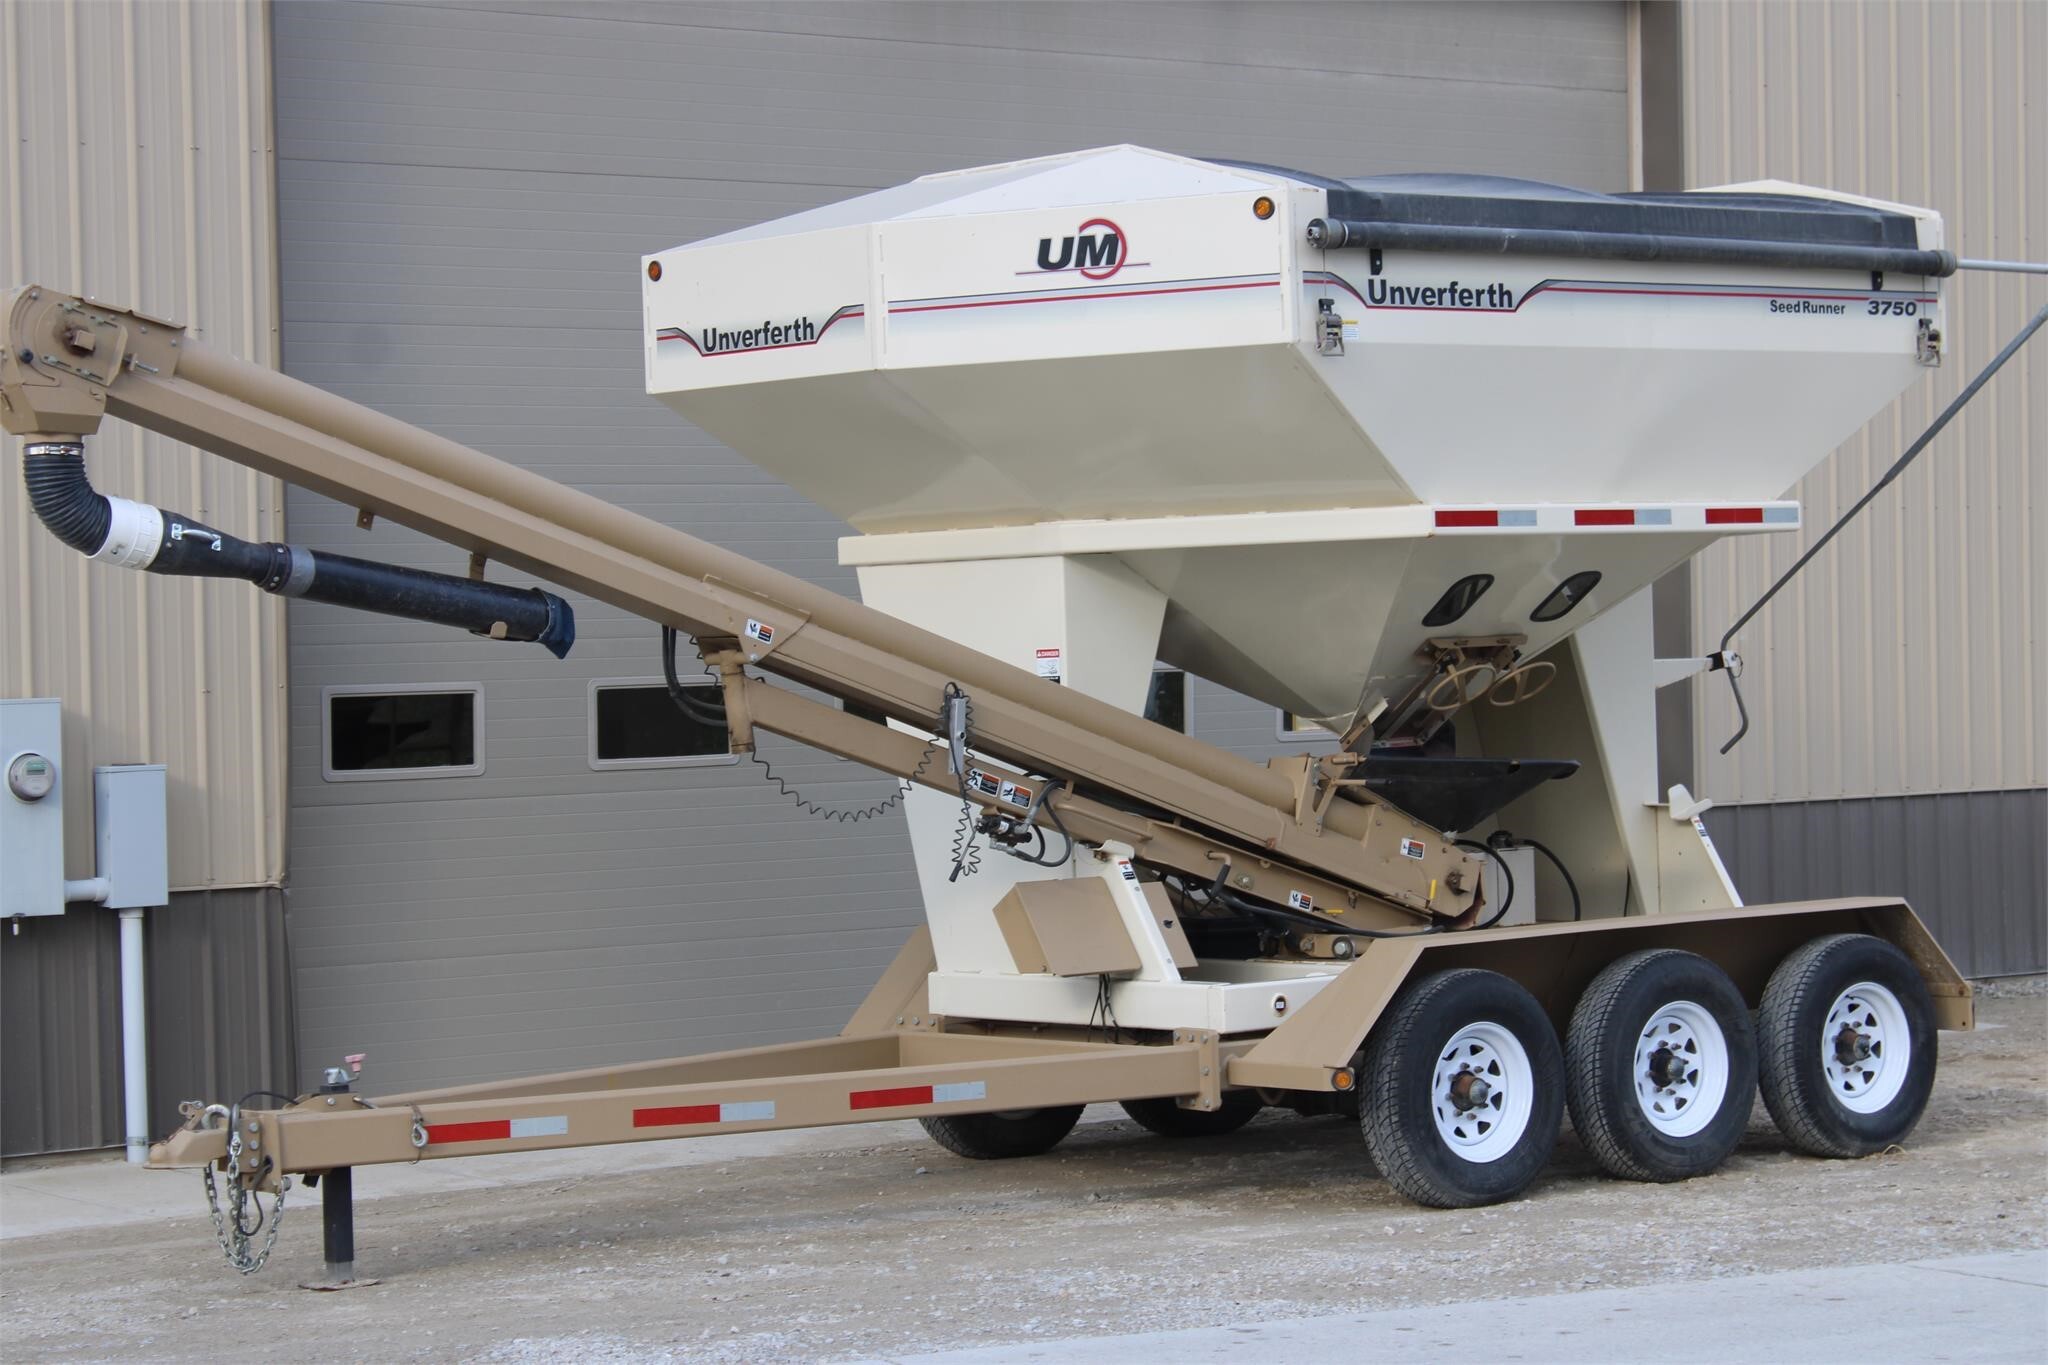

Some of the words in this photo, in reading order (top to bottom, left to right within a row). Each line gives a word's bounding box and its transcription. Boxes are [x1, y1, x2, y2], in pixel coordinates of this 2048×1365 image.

[1037, 233, 1120, 270] UM
[1368, 278, 1513, 308] Unverferth
[1770, 299, 1801, 313] Seed
[1803, 301, 1846, 315] Runner
[1867, 301, 1917, 316] 3750
[703, 317, 814, 352] Unverferth
